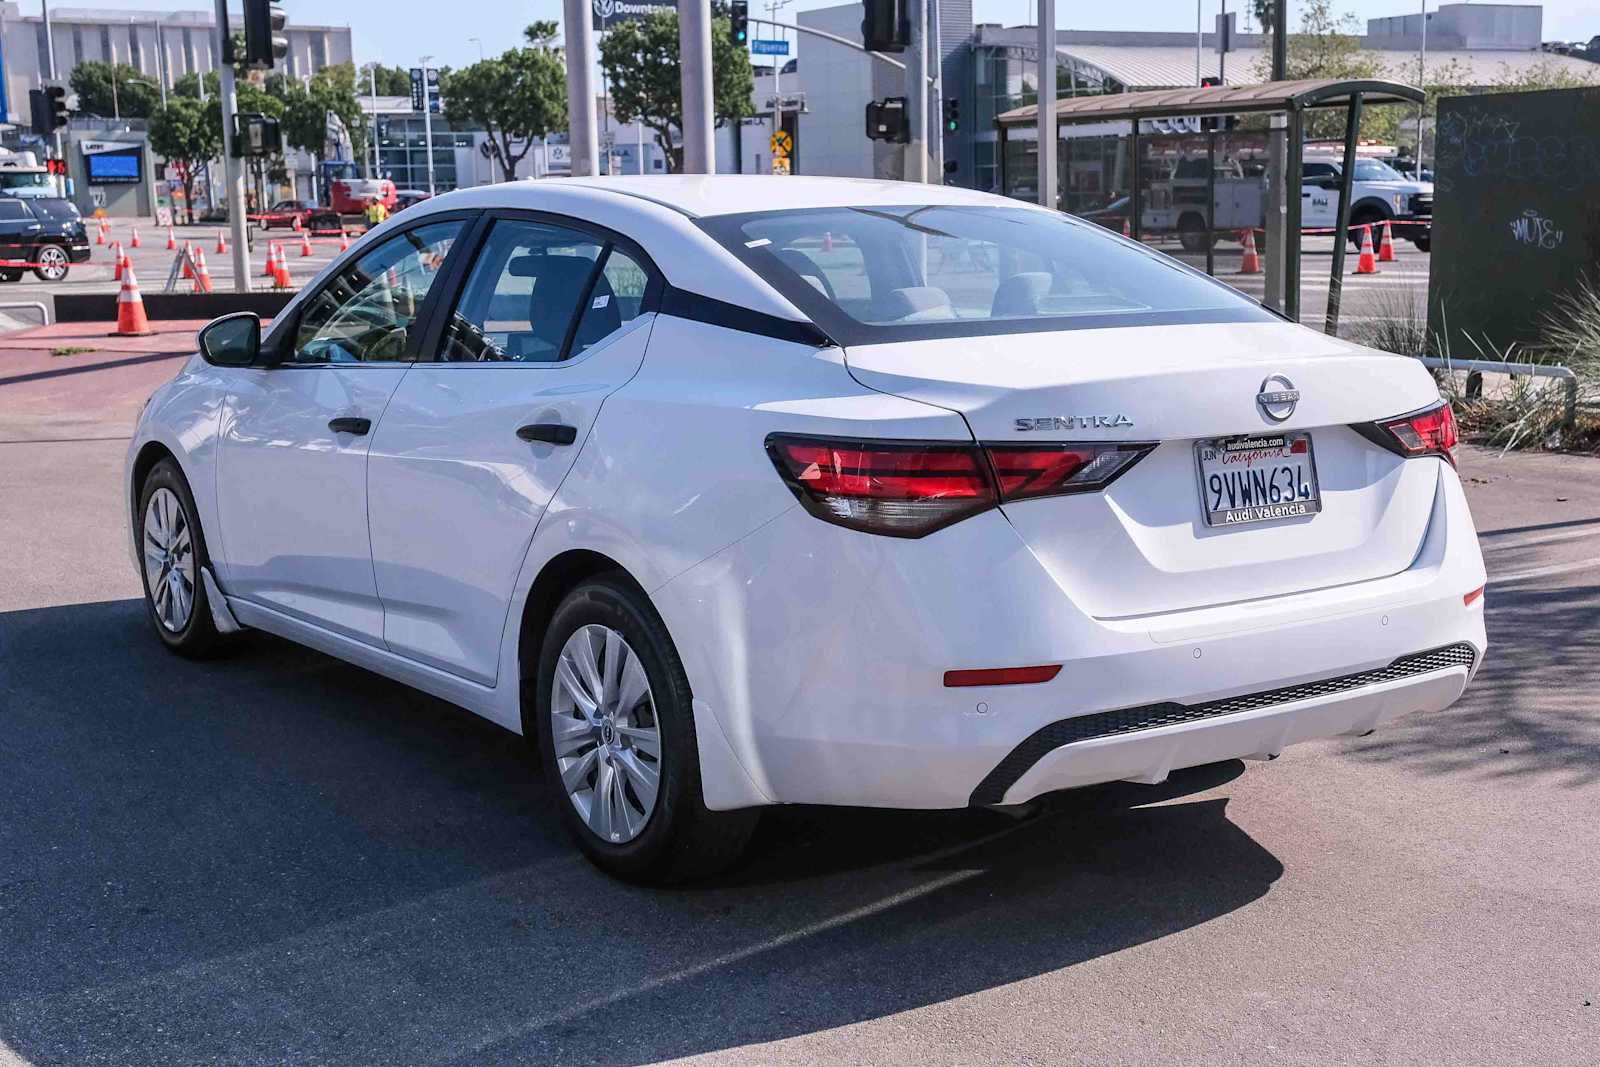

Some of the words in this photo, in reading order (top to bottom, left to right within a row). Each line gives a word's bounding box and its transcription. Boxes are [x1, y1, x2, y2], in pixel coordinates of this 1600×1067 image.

[1258, 391, 1299, 403] NISSAN
[1014, 413, 1134, 432] SENTRA
[1226, 438, 1284, 451] audivalencia.com
[1203, 449, 1217, 461] JUN
[1209, 465, 1311, 511] 9VWN634
[1225, 508, 1253, 523] Audi
[1255, 503, 1306, 520] Valencia
